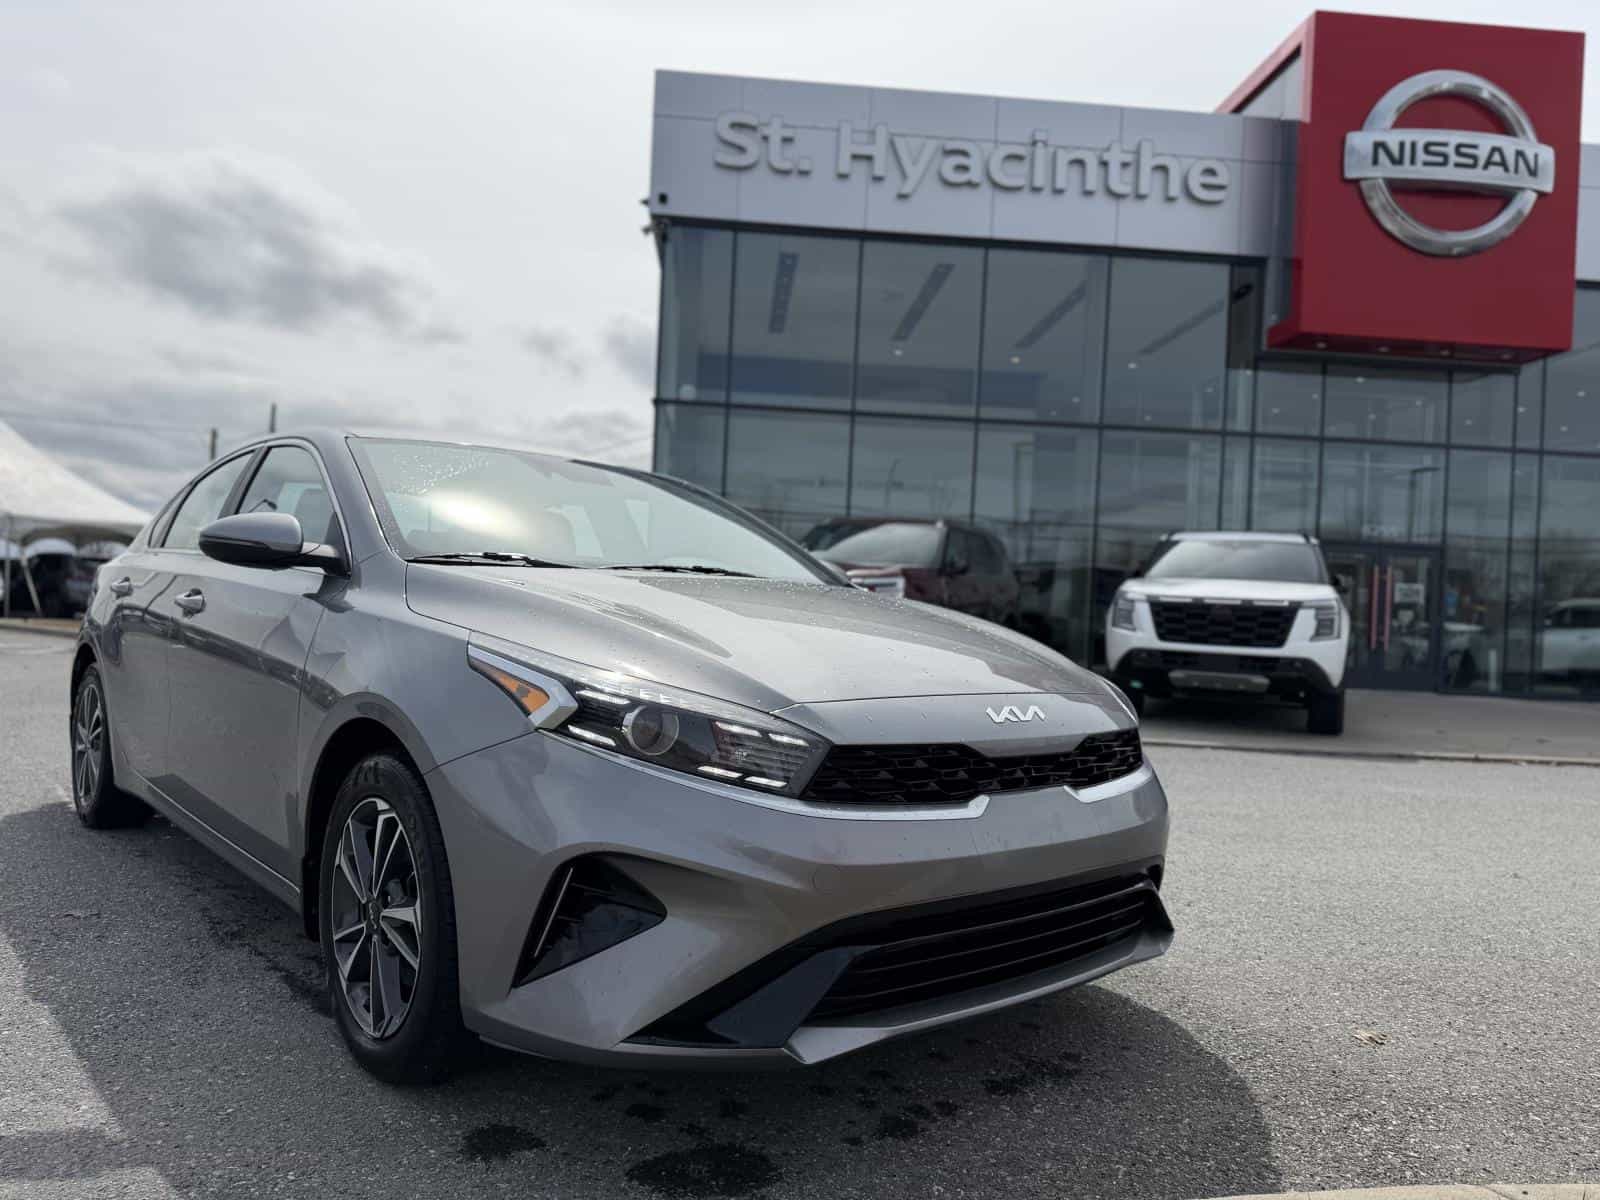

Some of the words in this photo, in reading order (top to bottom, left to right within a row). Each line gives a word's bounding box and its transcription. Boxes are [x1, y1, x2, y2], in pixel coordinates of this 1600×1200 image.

[714, 111, 812, 175] St.
[836, 121, 1229, 203] Hyacinthe
[1371, 140, 1539, 178] NISSAN
[986, 705, 1046, 724] KIA
